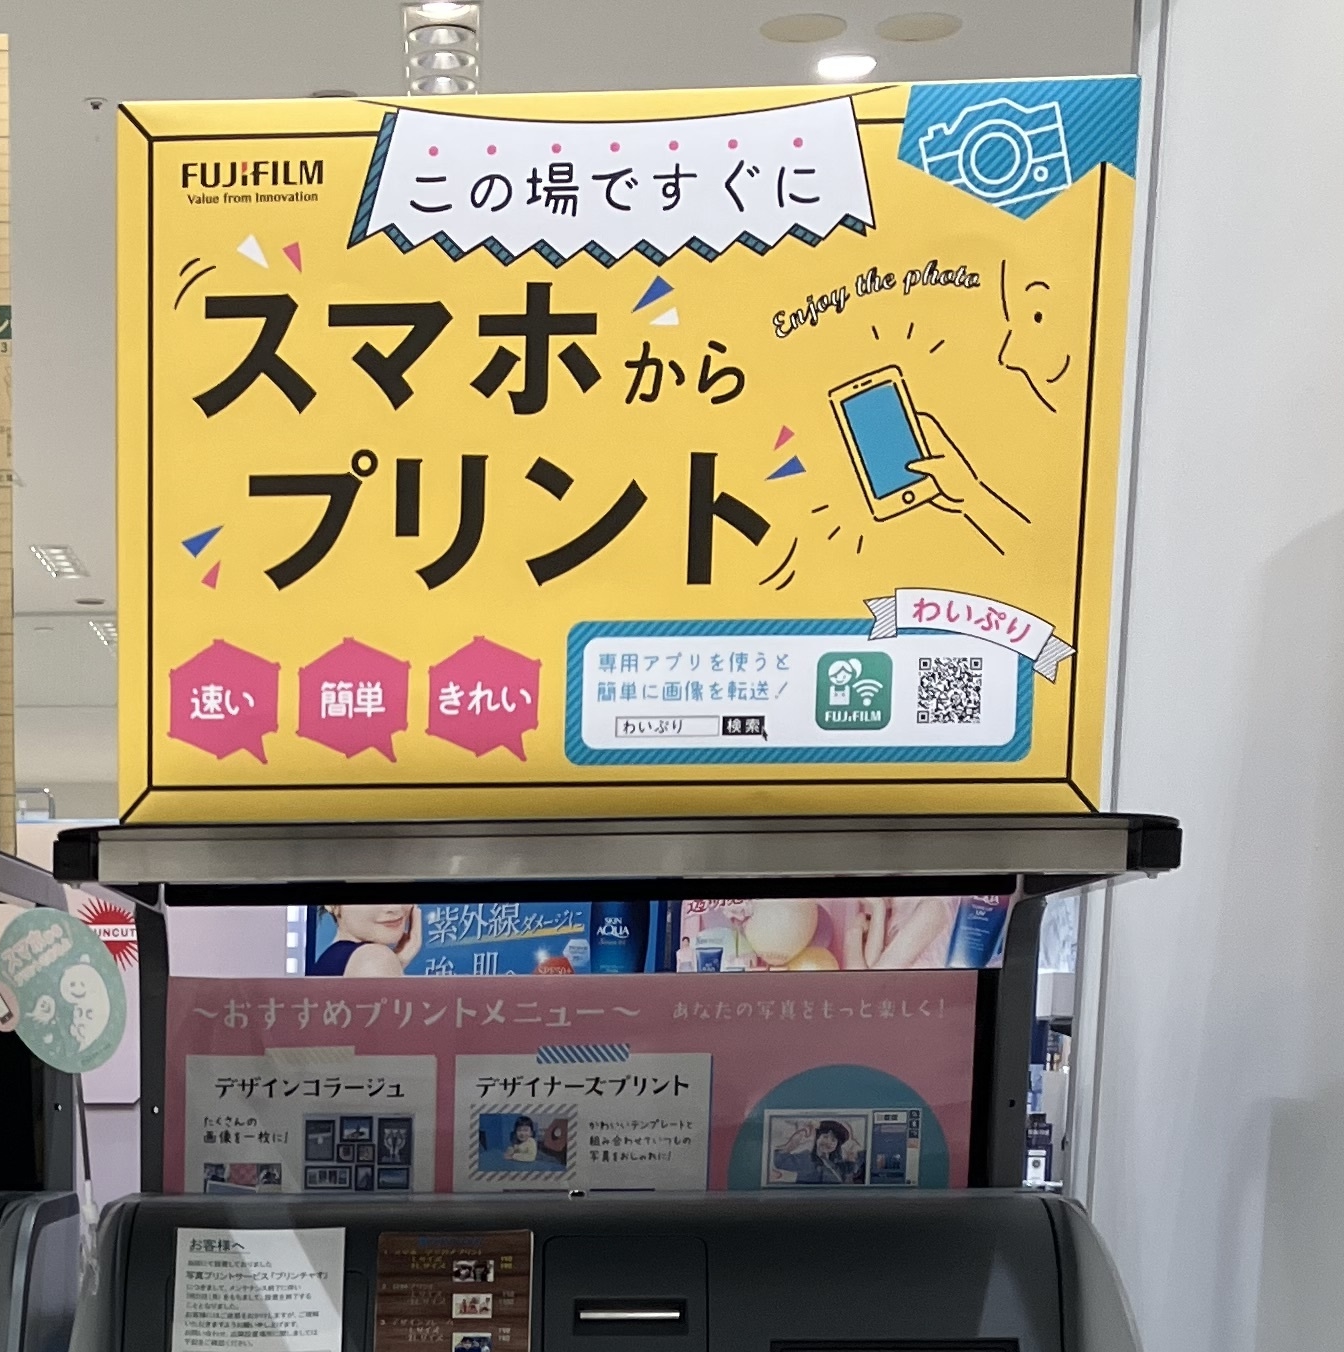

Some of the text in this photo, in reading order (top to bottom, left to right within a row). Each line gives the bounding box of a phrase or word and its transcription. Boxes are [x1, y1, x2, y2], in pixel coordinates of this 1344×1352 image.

[181, 159, 324, 189] FUJIFILM
[408, 158, 823, 218] この場ですぐに
[186, 191, 319, 204] Value from Innovation
[772, 259, 981, 338] Enjoy the photo
[192, 281, 749, 418] スマホから
[248, 448, 772, 592] プリント
[912, 597, 1031, 643] わいぷり
[598, 651, 792, 673] 専用アプリを使うと
[189, 686, 255, 722] 速い
[320, 682, 385, 720] 簡単
[436, 679, 532, 717] きれい
[622, 717, 762, 735] わいぷり 検索
[824, 710, 882, 723] FUJIFILM
[214, 1076, 406, 1100] デザインコラージュ
[475, 1074, 690, 1100] デザイナーズプリント
[189, 1237, 246, 1252] お客様へ
